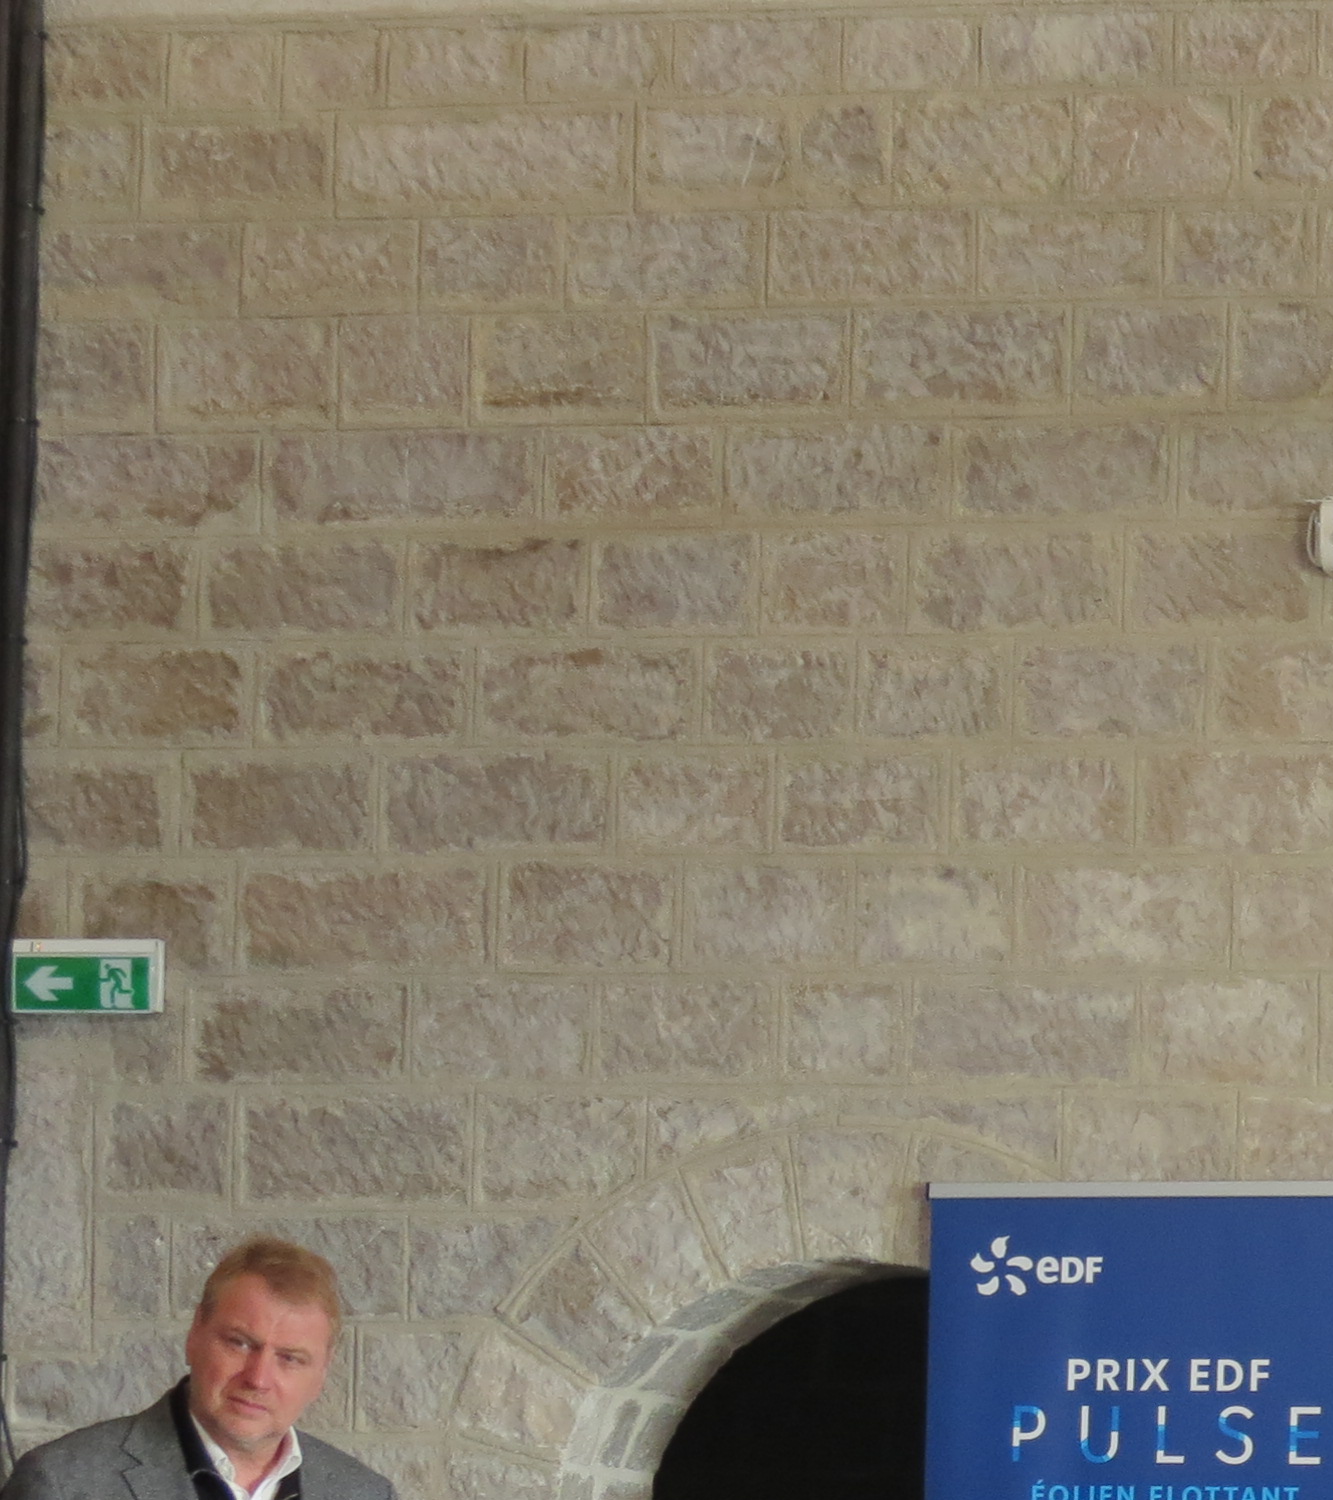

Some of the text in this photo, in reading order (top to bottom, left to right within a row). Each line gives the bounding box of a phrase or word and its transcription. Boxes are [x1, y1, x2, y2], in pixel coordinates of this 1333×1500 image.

[1066, 1358, 1271, 1393] PRIX EDF
[1012, 1405, 1322, 1465] PULSE
